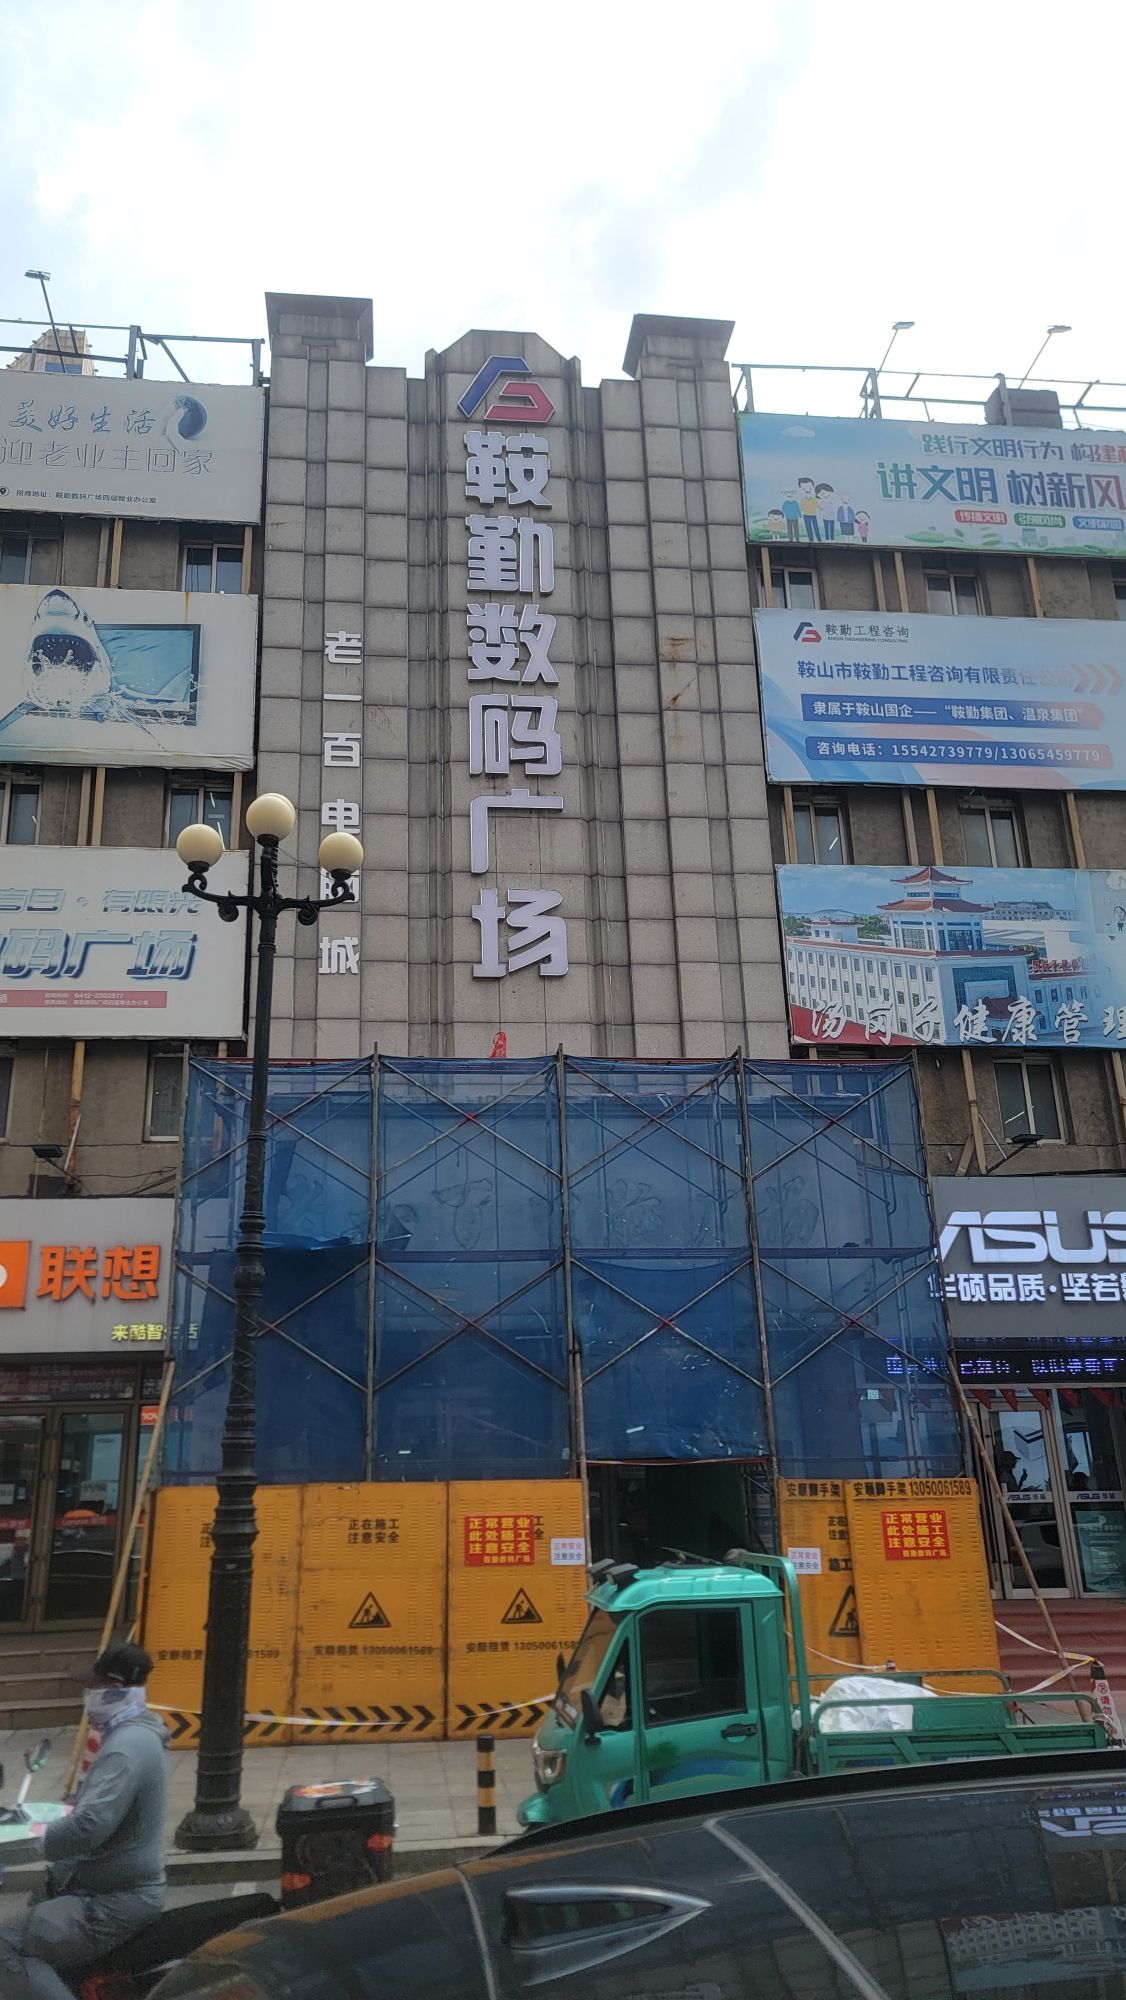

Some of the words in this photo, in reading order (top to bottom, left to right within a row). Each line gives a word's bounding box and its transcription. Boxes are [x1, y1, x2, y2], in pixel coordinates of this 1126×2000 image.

[8, 399, 156, 435] 美好生活
[0, 437, 214, 475] 迎老业主回家
[922, 432, 1064, 462] 践行文明行为
[877, 461, 999, 504] 讲文明
[1006, 469, 1126, 511] 树新风
[824, 622, 910, 639] 鞍勤工程咨询
[464, 429, 570, 979] 鞍勤数码广场
[0, 928, 198, 980] 码广场
[36, 1245, 162, 1302] 联想
[927, 1272, 1126, 1302] 华硕品质·坚若
[349, 1518, 400, 1531] 正在施工
[469, 1517, 531, 1529] 正常营业
[886, 1513, 943, 1525] 正常营业
[348, 1531, 400, 1544] 注意安全
[469, 1542, 531, 1555] 注意安全
[888, 1537, 946, 1548] 注意安全
